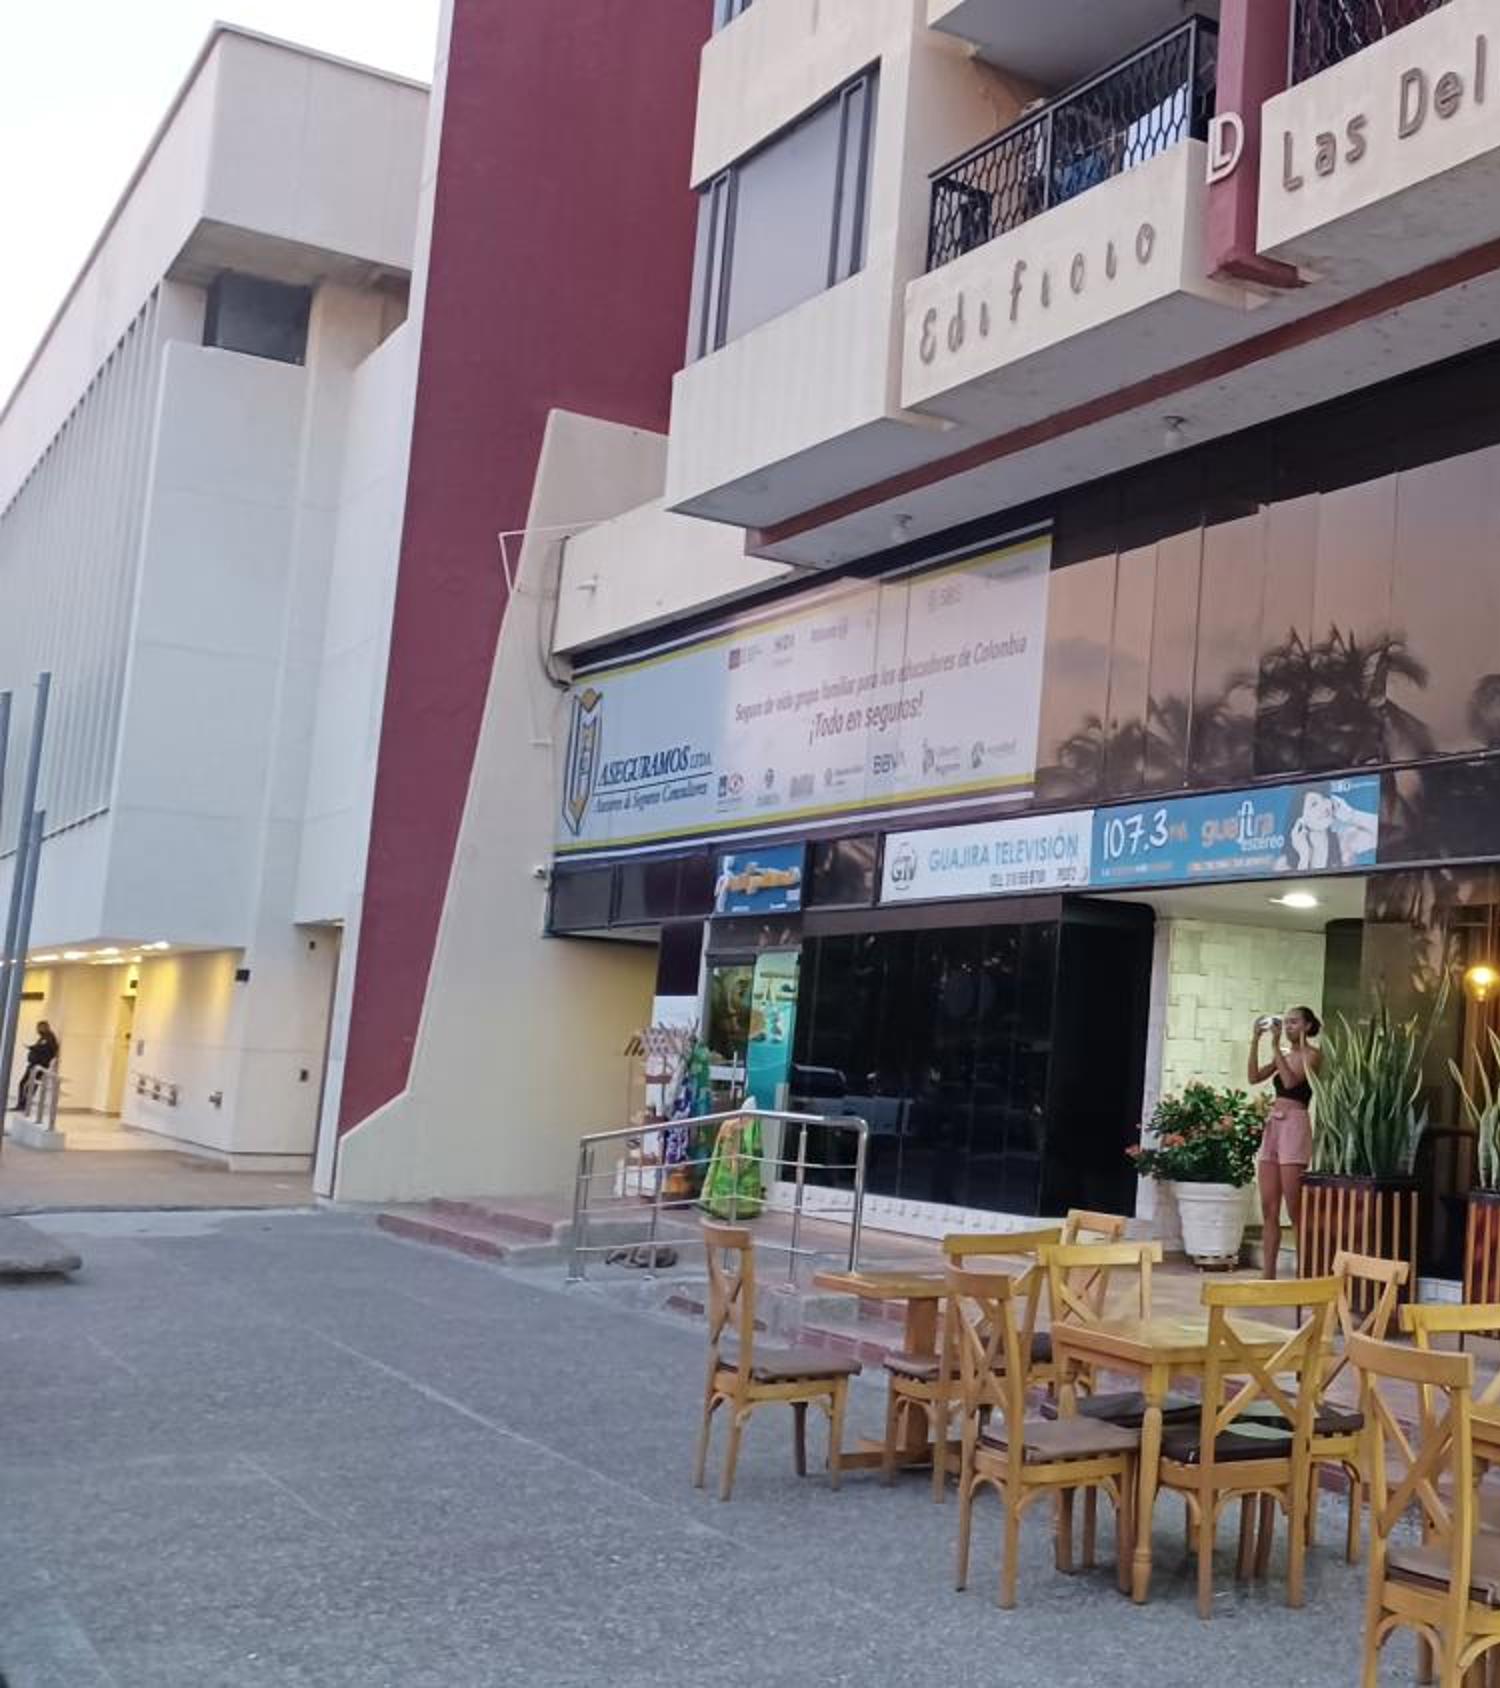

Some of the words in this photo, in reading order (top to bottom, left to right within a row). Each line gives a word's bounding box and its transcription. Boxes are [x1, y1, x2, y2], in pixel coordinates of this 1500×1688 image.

[1283, 113, 1368, 192] Las
[919, 222, 1156, 365] Edificio
[958, 647, 971, 669] de
[973, 632, 1028, 664] Colombia
[808, 706, 844, 745] ¡Todo
[846, 708, 862, 732] en
[865, 690, 923, 733] seguros!
[597, 745, 691, 787] ASEGURAMOS
[928, 845, 990, 872] GUAJIRA
[994, 826, 1079, 866] TELEVISIÓN
[1103, 809, 1168, 861] 107.3
